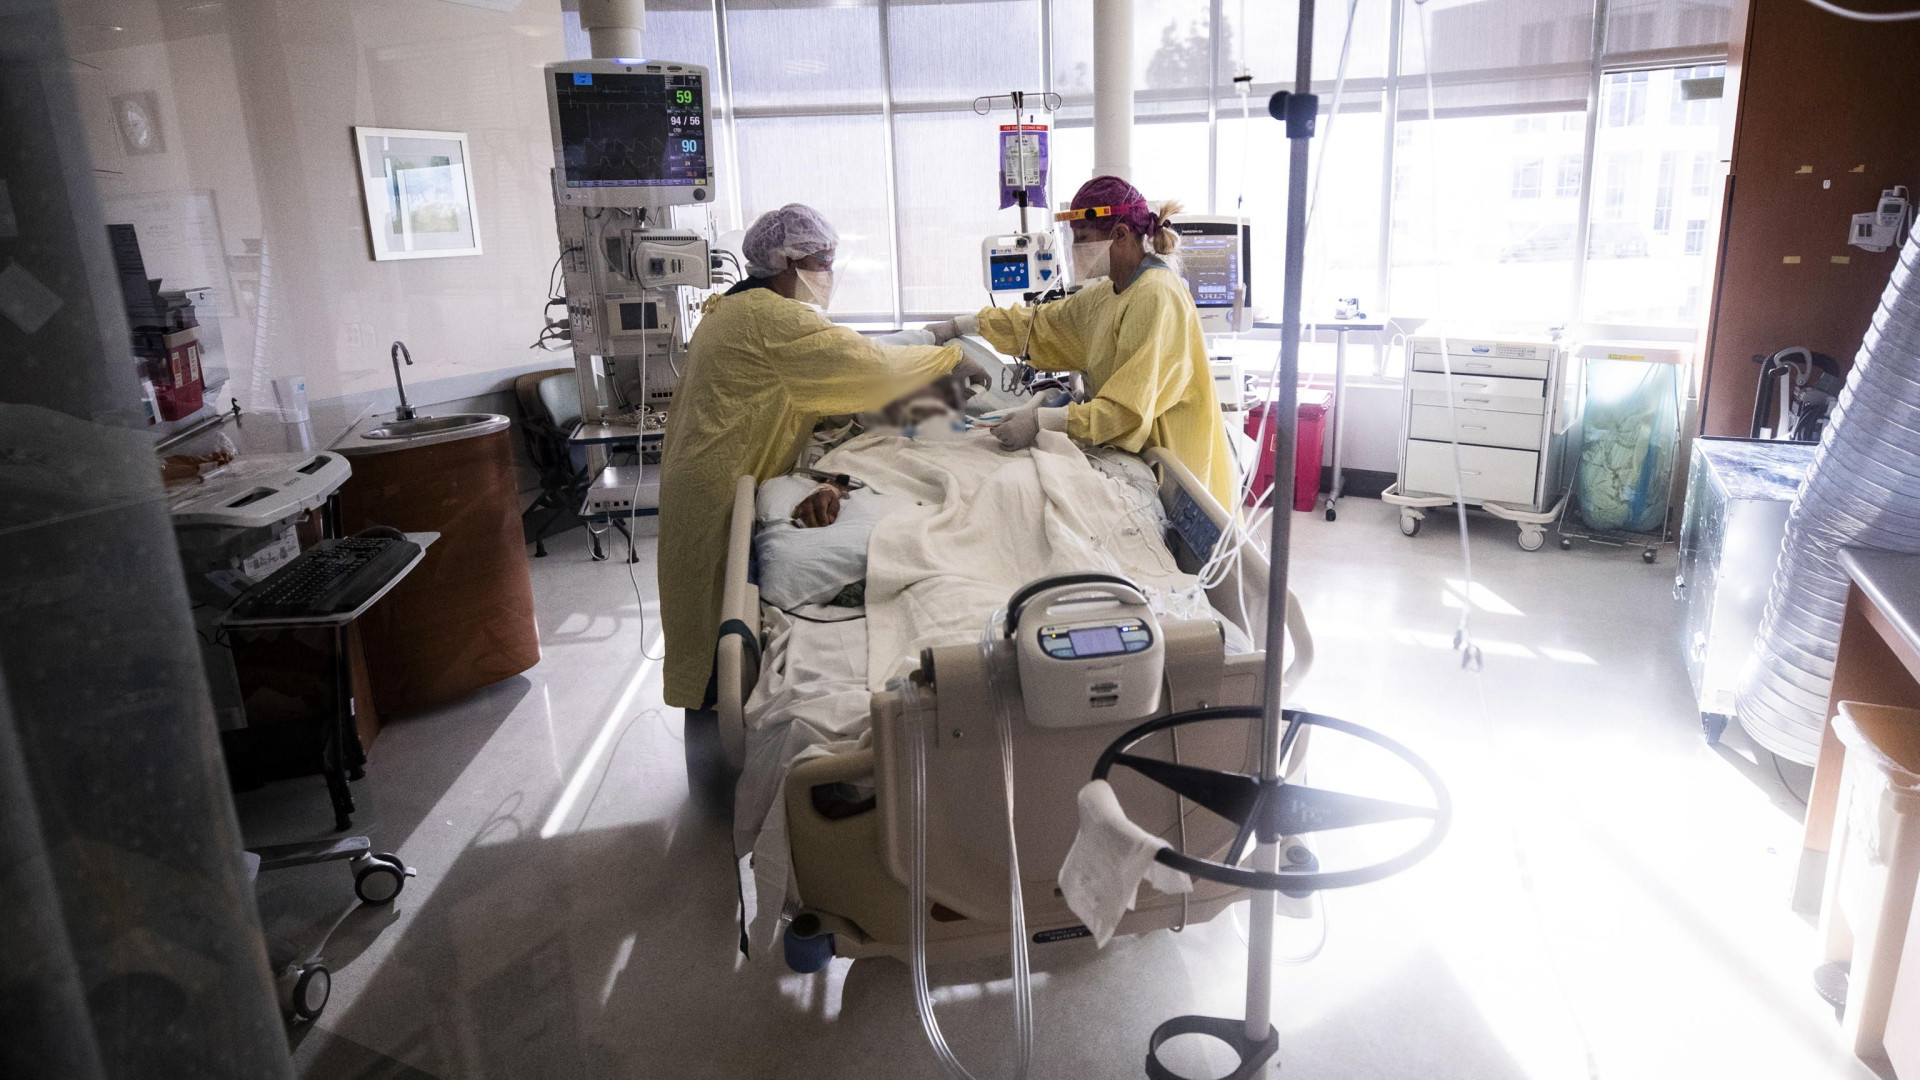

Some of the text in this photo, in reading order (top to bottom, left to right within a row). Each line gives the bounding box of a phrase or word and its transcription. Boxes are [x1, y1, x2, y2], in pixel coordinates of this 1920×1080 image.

[676, 90, 692, 103] 59
[670, 116, 681, 125] 94
[689, 116, 700, 125] 56
[681, 139, 697, 152] 90
